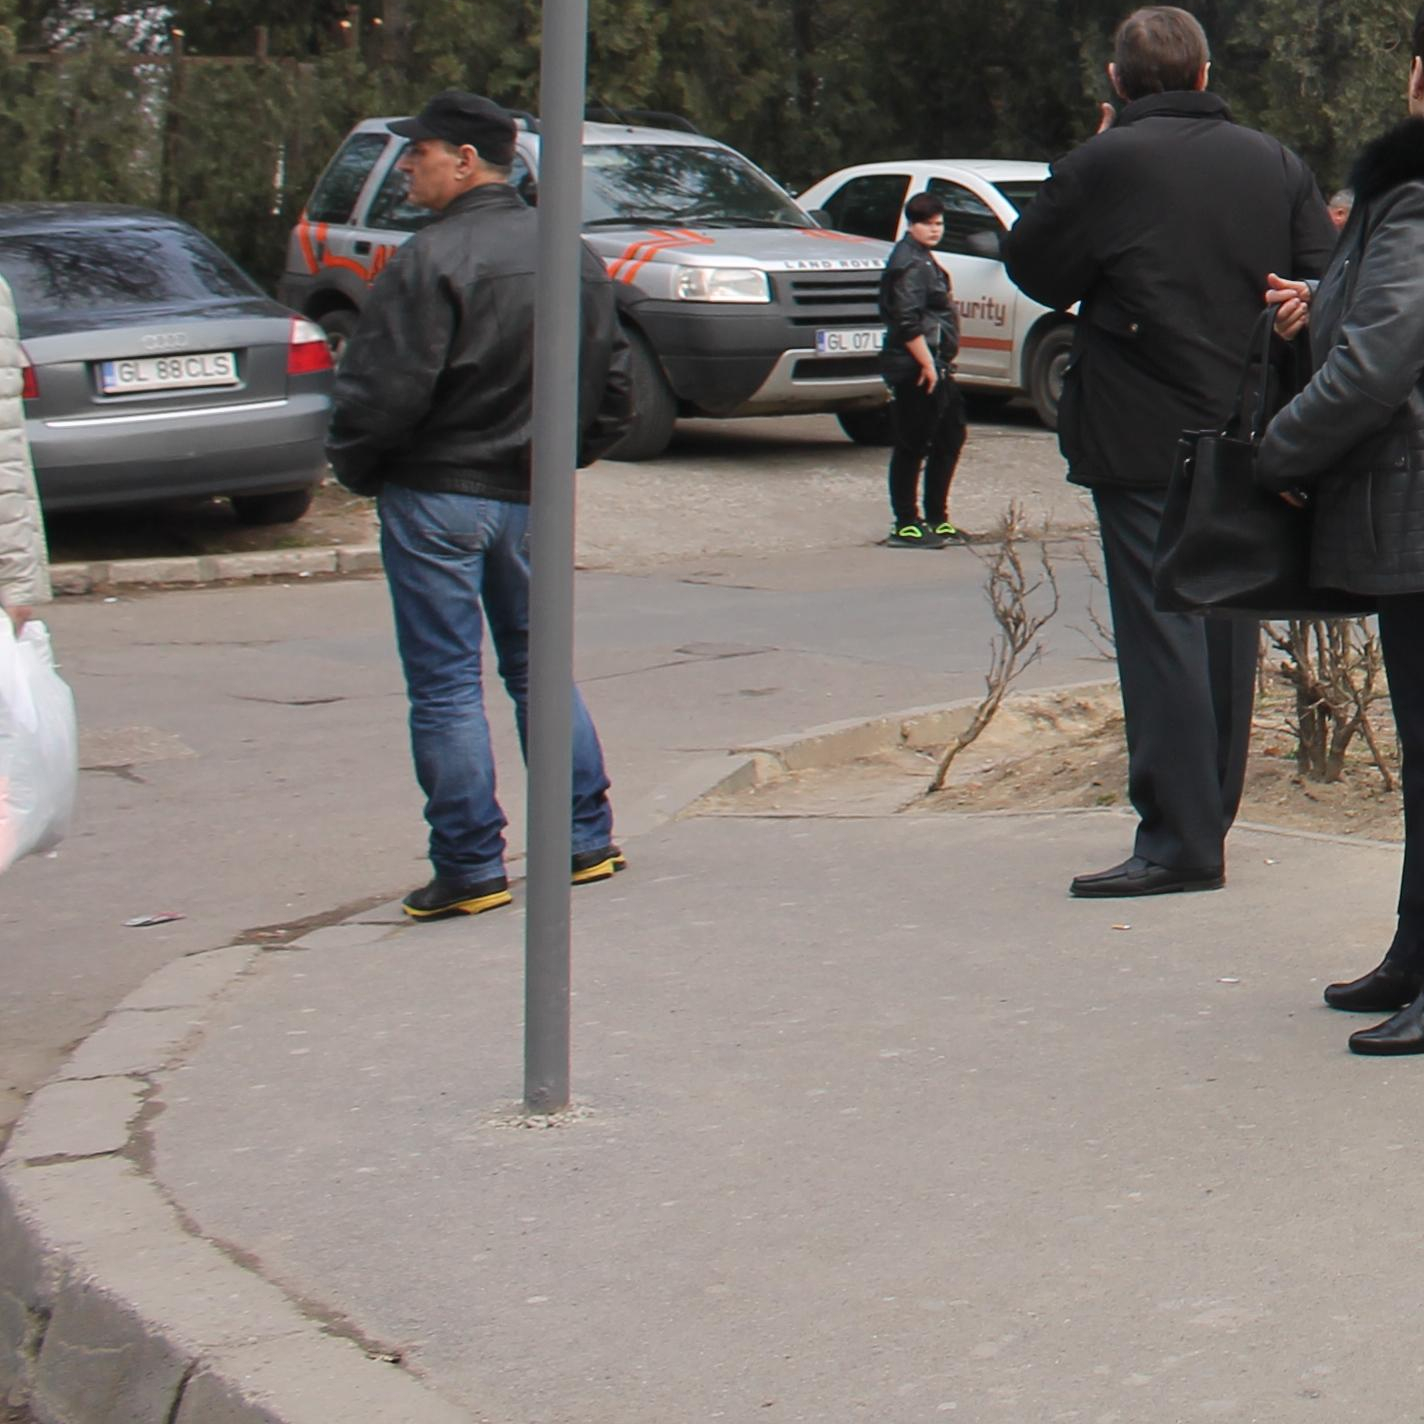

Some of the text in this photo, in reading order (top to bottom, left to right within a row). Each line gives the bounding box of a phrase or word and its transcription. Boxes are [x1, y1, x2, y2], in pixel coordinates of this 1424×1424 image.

[785, 259, 884, 269] LAND ROVE
[954, 296, 1007, 327] urity
[827, 333, 848, 351] GL
[118, 362, 148, 383] GL
